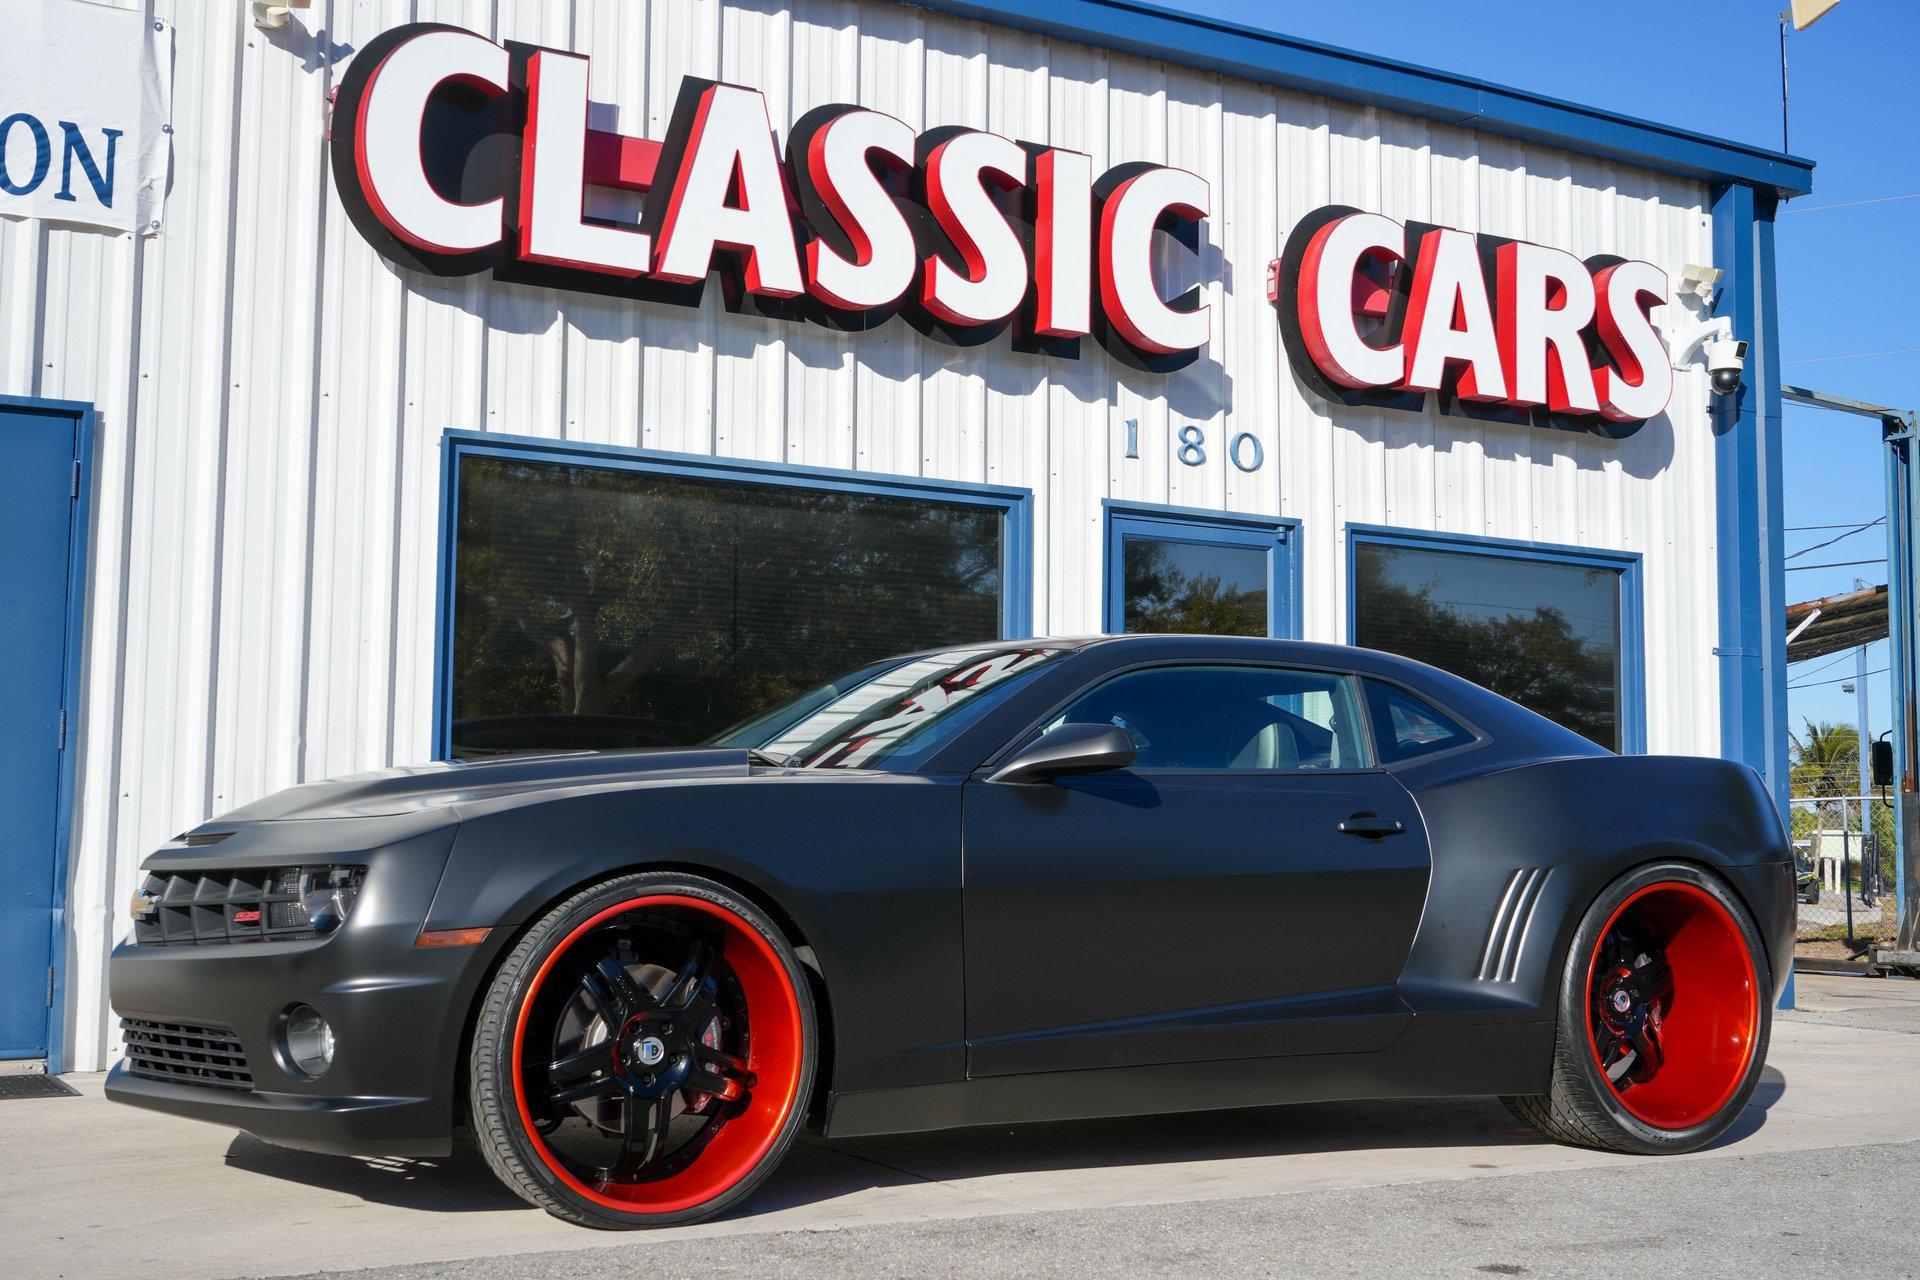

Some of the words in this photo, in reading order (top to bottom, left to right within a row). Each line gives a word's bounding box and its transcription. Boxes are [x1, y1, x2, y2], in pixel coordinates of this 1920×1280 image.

[0, 113, 123, 209] ON
[352, 28, 1211, 355] CLASSIC
[1296, 211, 1674, 424] CARS
